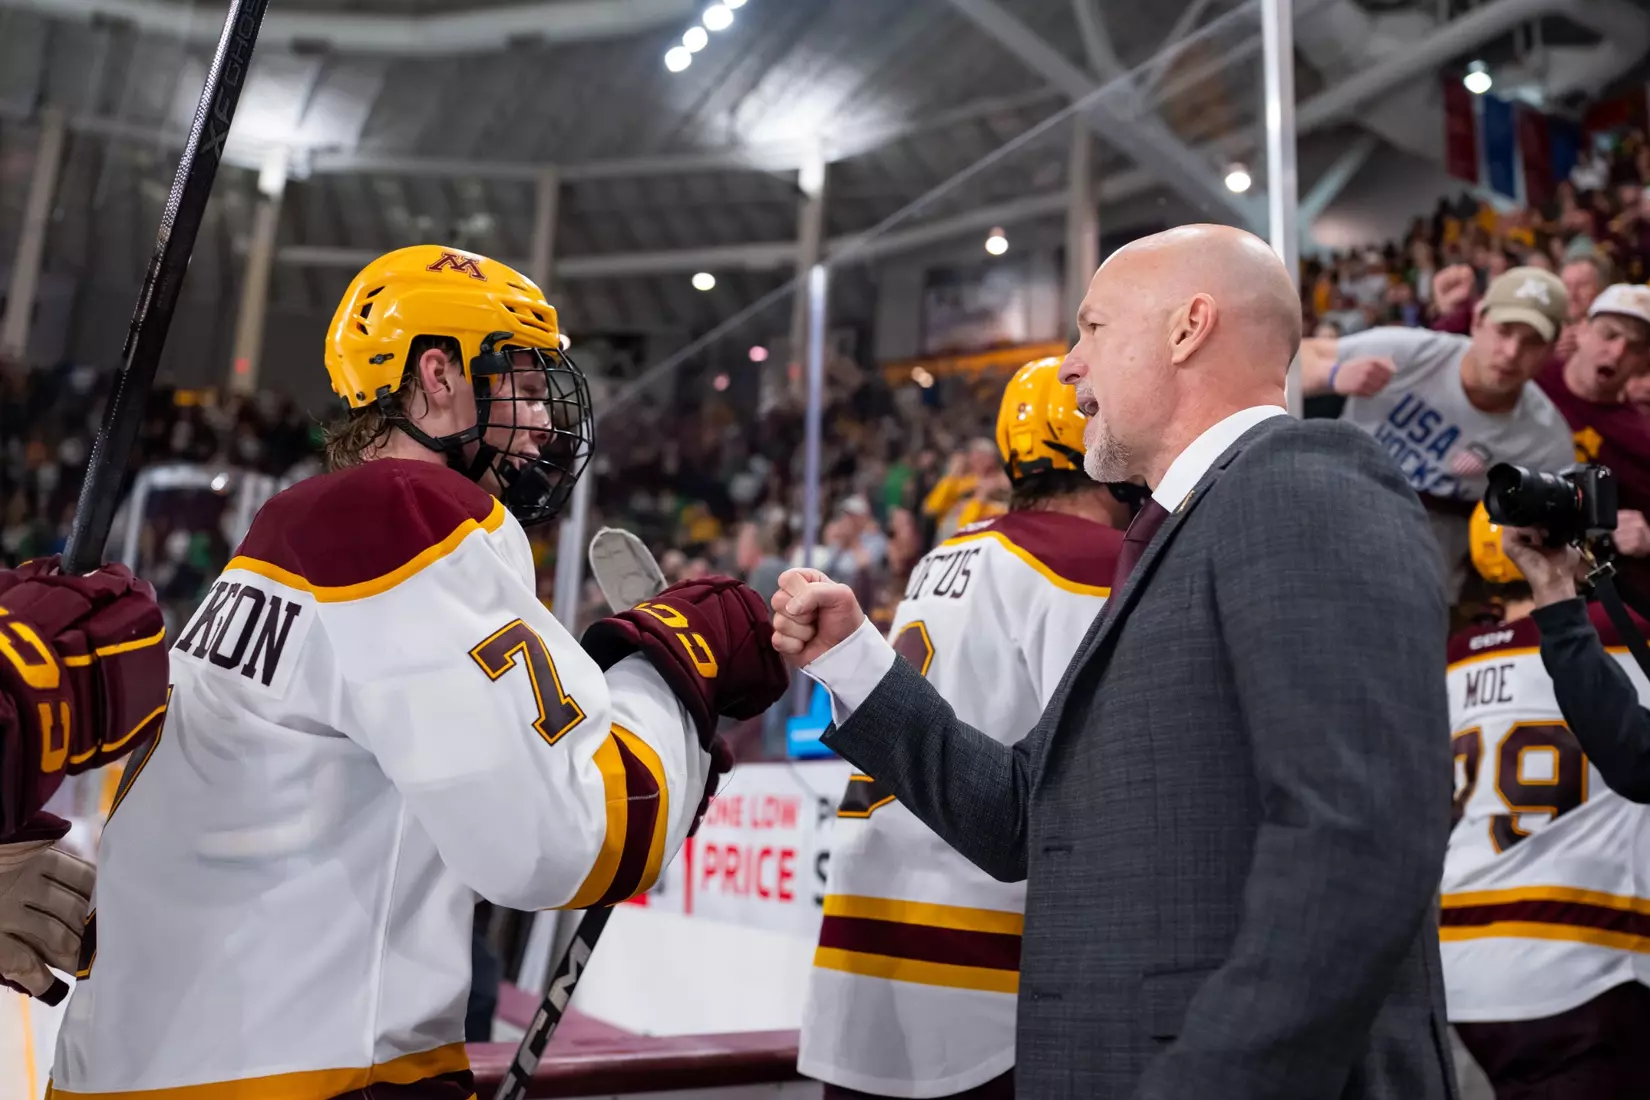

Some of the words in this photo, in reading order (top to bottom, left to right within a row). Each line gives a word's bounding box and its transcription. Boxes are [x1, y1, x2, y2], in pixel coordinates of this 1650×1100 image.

[426, 252, 487, 282] M
[1388, 391, 1461, 461] USA
[468, 617, 587, 747] 7
[1464, 663, 1515, 709] MOE
[749, 795, 801, 830] LOW
[701, 842, 798, 902] PRICE
